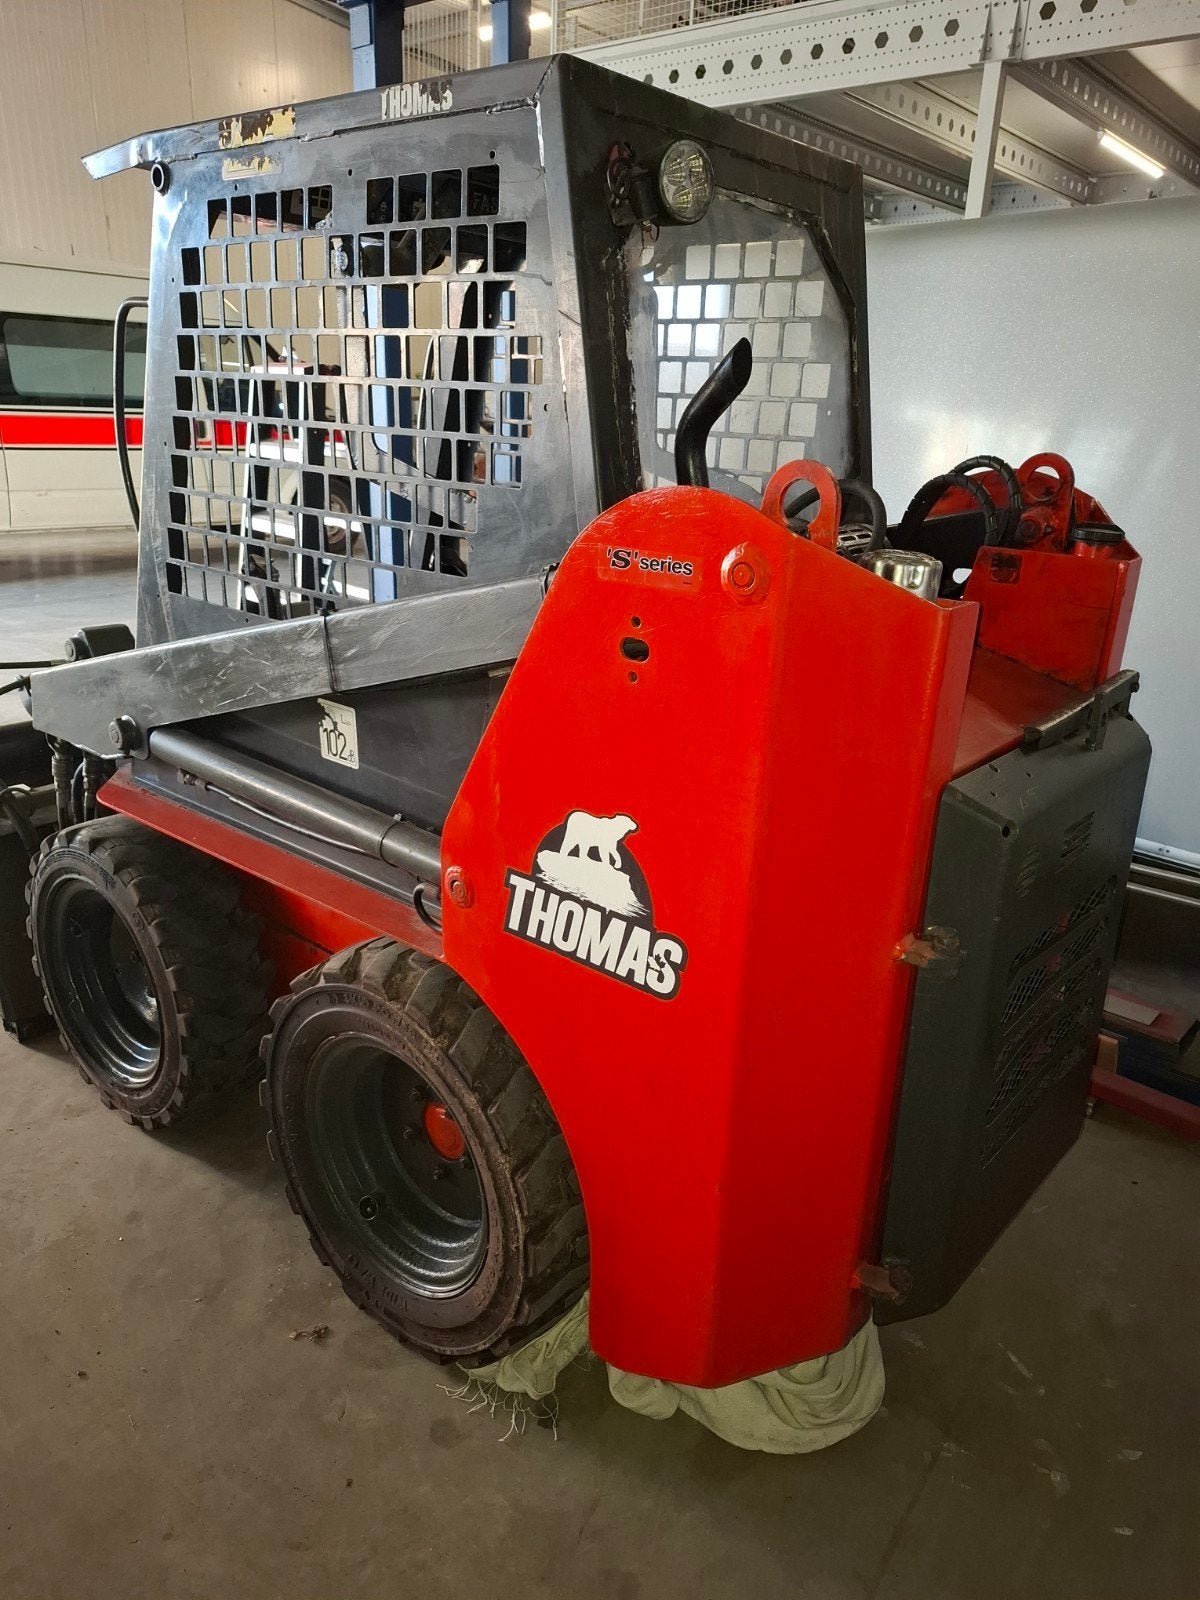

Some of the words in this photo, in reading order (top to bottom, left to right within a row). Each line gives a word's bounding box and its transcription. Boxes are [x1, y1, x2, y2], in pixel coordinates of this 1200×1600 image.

[640, 556, 693, 576] series
[322, 728, 347, 760] 102
[508, 874, 683, 994] THOMAS
